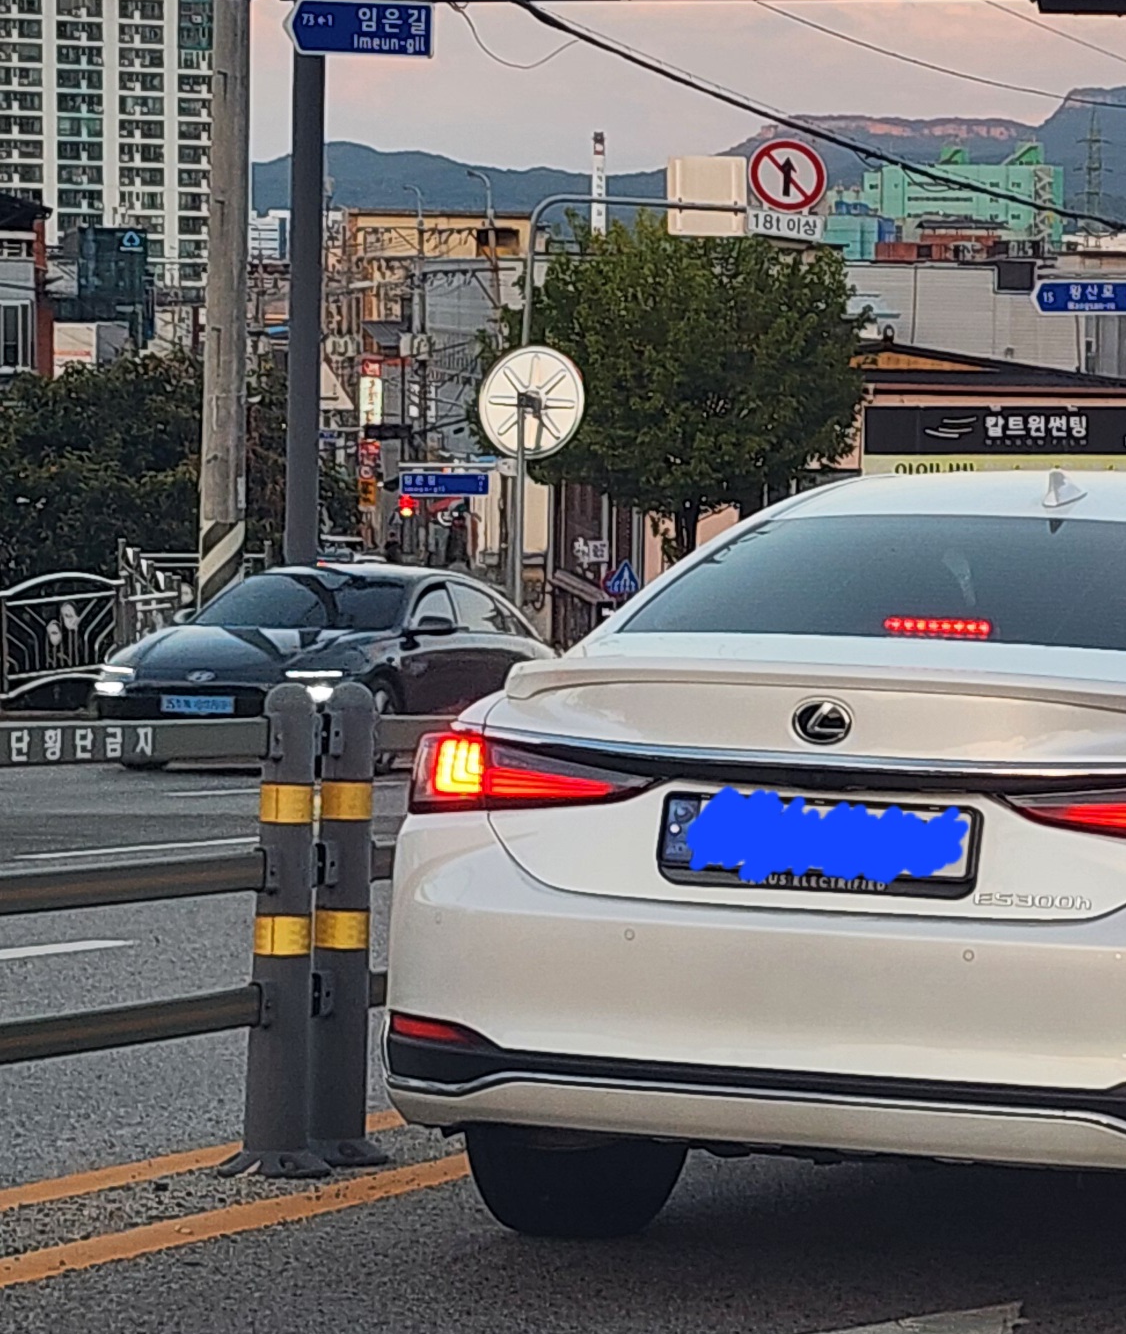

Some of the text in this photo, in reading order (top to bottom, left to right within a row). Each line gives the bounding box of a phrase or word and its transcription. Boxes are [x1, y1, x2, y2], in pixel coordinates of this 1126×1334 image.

[358, 7, 426, 35] 임은길
[353, 33, 426, 54] Imeun-gil
[753, 213, 817, 236] 18t 이상
[973, 892, 1093, 910] ES300h
